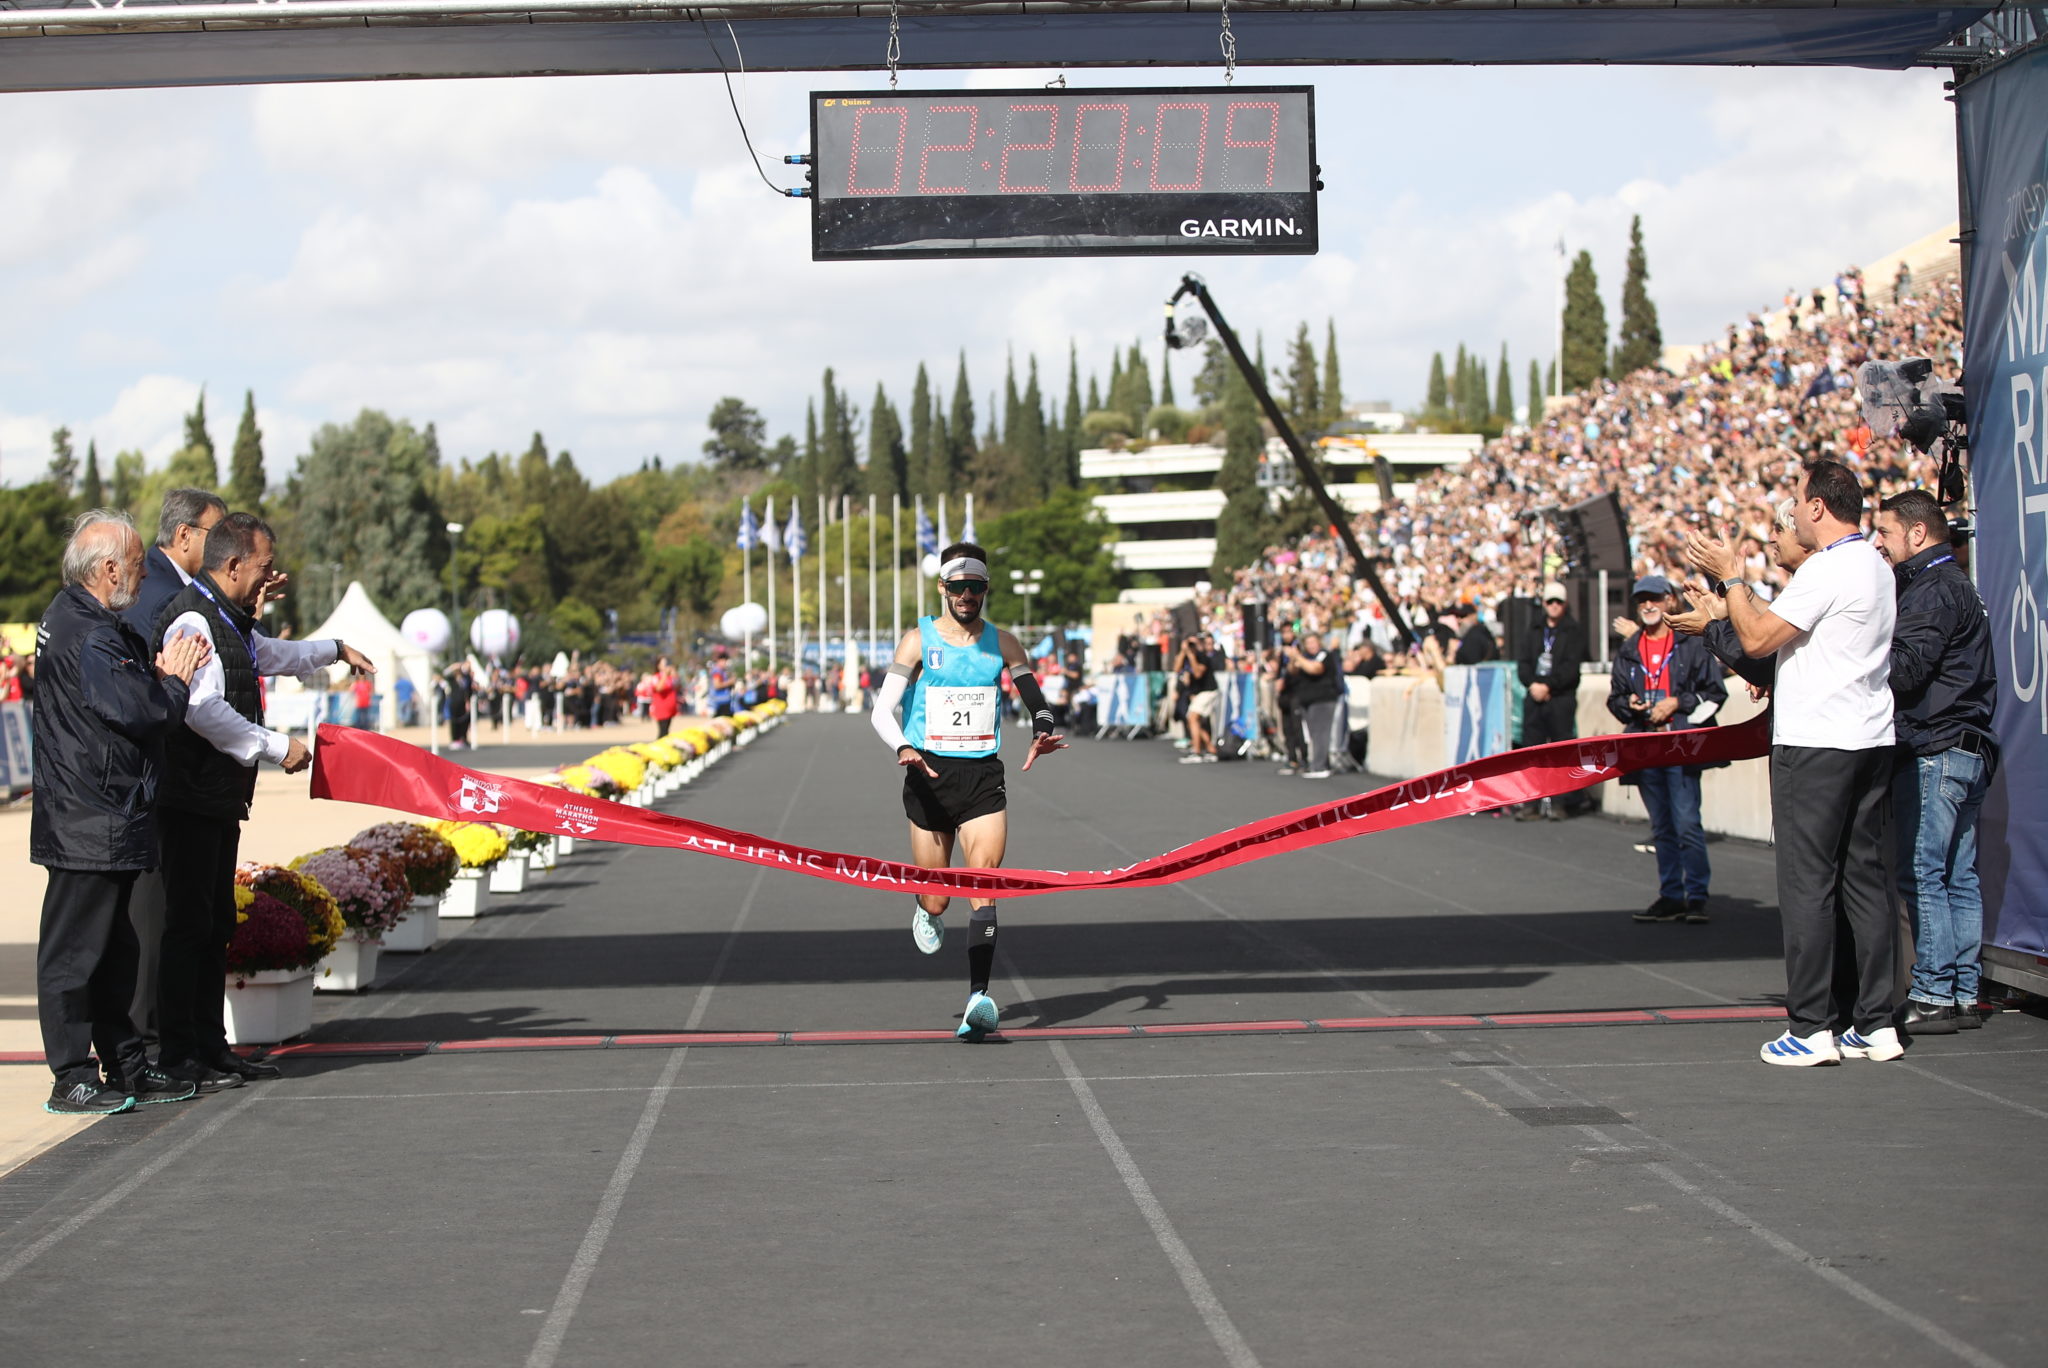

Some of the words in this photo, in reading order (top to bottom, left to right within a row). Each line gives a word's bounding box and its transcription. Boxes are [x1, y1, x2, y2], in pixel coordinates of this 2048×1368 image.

[847, 101, 1280, 196] 02:20:09
[952, 711, 971, 726] 21
[555, 808, 599, 822] MARATHON
[563, 802, 594, 814] ATHENS
